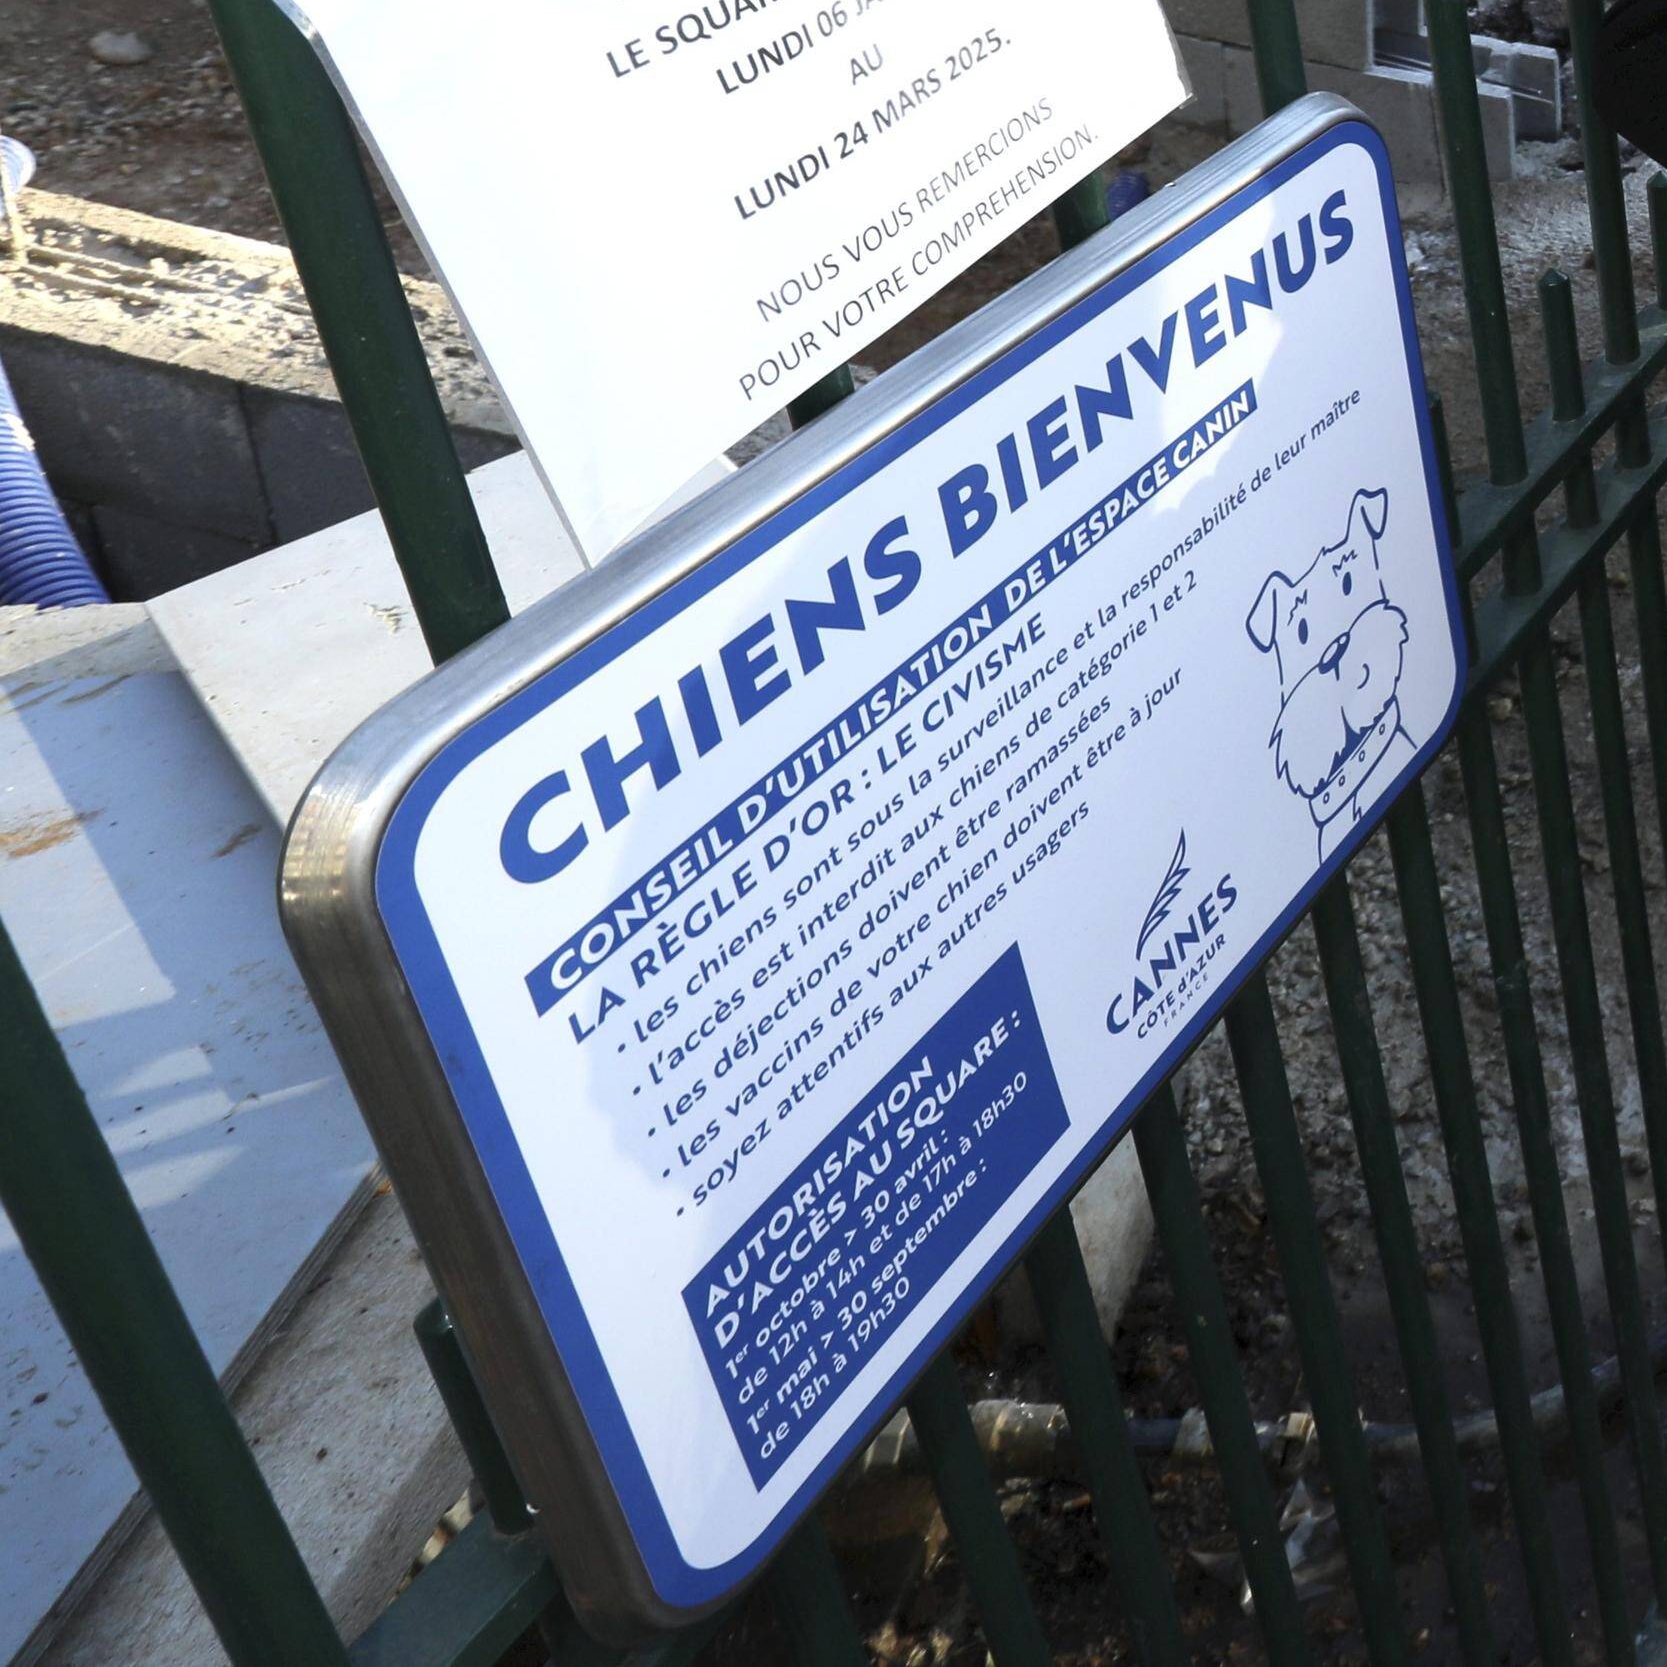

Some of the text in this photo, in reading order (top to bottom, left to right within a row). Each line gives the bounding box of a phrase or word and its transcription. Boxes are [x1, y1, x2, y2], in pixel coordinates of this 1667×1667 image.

[606, 38, 650, 78] LE
[716, 24, 814, 95] LUNDI
[817, 0, 848, 37] 06
[734, 28, 1011, 220] LUNDI 24 MARS 2025.
[850, 44, 882, 86] AU
[739, 128, 1098, 401] POUR VOTRE COMPREHENSION.
[756, 105, 1052, 322] NOUS VOUS REMERCIONS
[499, 189, 1354, 885] CHIENS BIENVENUS
[551, 390, 1249, 990] CONSEIL D'UTILISATION DE L'ESPACE CANIN
[633, 389, 1361, 1043] les chiens sont sous la surveillance et la responsabilité de leur maître
[568, 986, 626, 1044] LA
[630, 860, 758, 989] RÈGLE
[762, 779, 855, 873] D'OR
[877, 722, 917, 775] LE
[922, 612, 1046, 733] CIVISME
[648, 569, 1197, 1085] l'accès est interdit aux chiens de catégorie 1 et 2
[663, 695, 1111, 1126] les déjections doivent être ramassées
[677, 667, 1181, 1167] les vaccins de votre chien doivent être à jour
[1106, 873, 1238, 1035] CANNES
[693, 801, 1089, 1207] soyez attentifs aux autres usagers
[1137, 933, 1226, 1039] CÔTE d'AZUR
[1163, 972, 1208, 1028] FRANCE
[706, 1055, 933, 1318] AUTORISATION
[714, 1191, 847, 1349] D'ACCÈS
[853, 1140, 893, 1202] AU
[896, 1017, 1009, 1149] SQUARE
[739, 1071, 1027, 1404] de 12h à 14h et de 17h à 18h30
[756, 1248, 841, 1348] octobre
[860, 1189, 890, 1229] 30
[894, 1137, 940, 1194] avril
[776, 1346, 818, 1404] mai
[837, 1290, 867, 1331] 30
[871, 1170, 977, 1295] septembre
[760, 1276, 910, 1459] de 18h à 19h30
